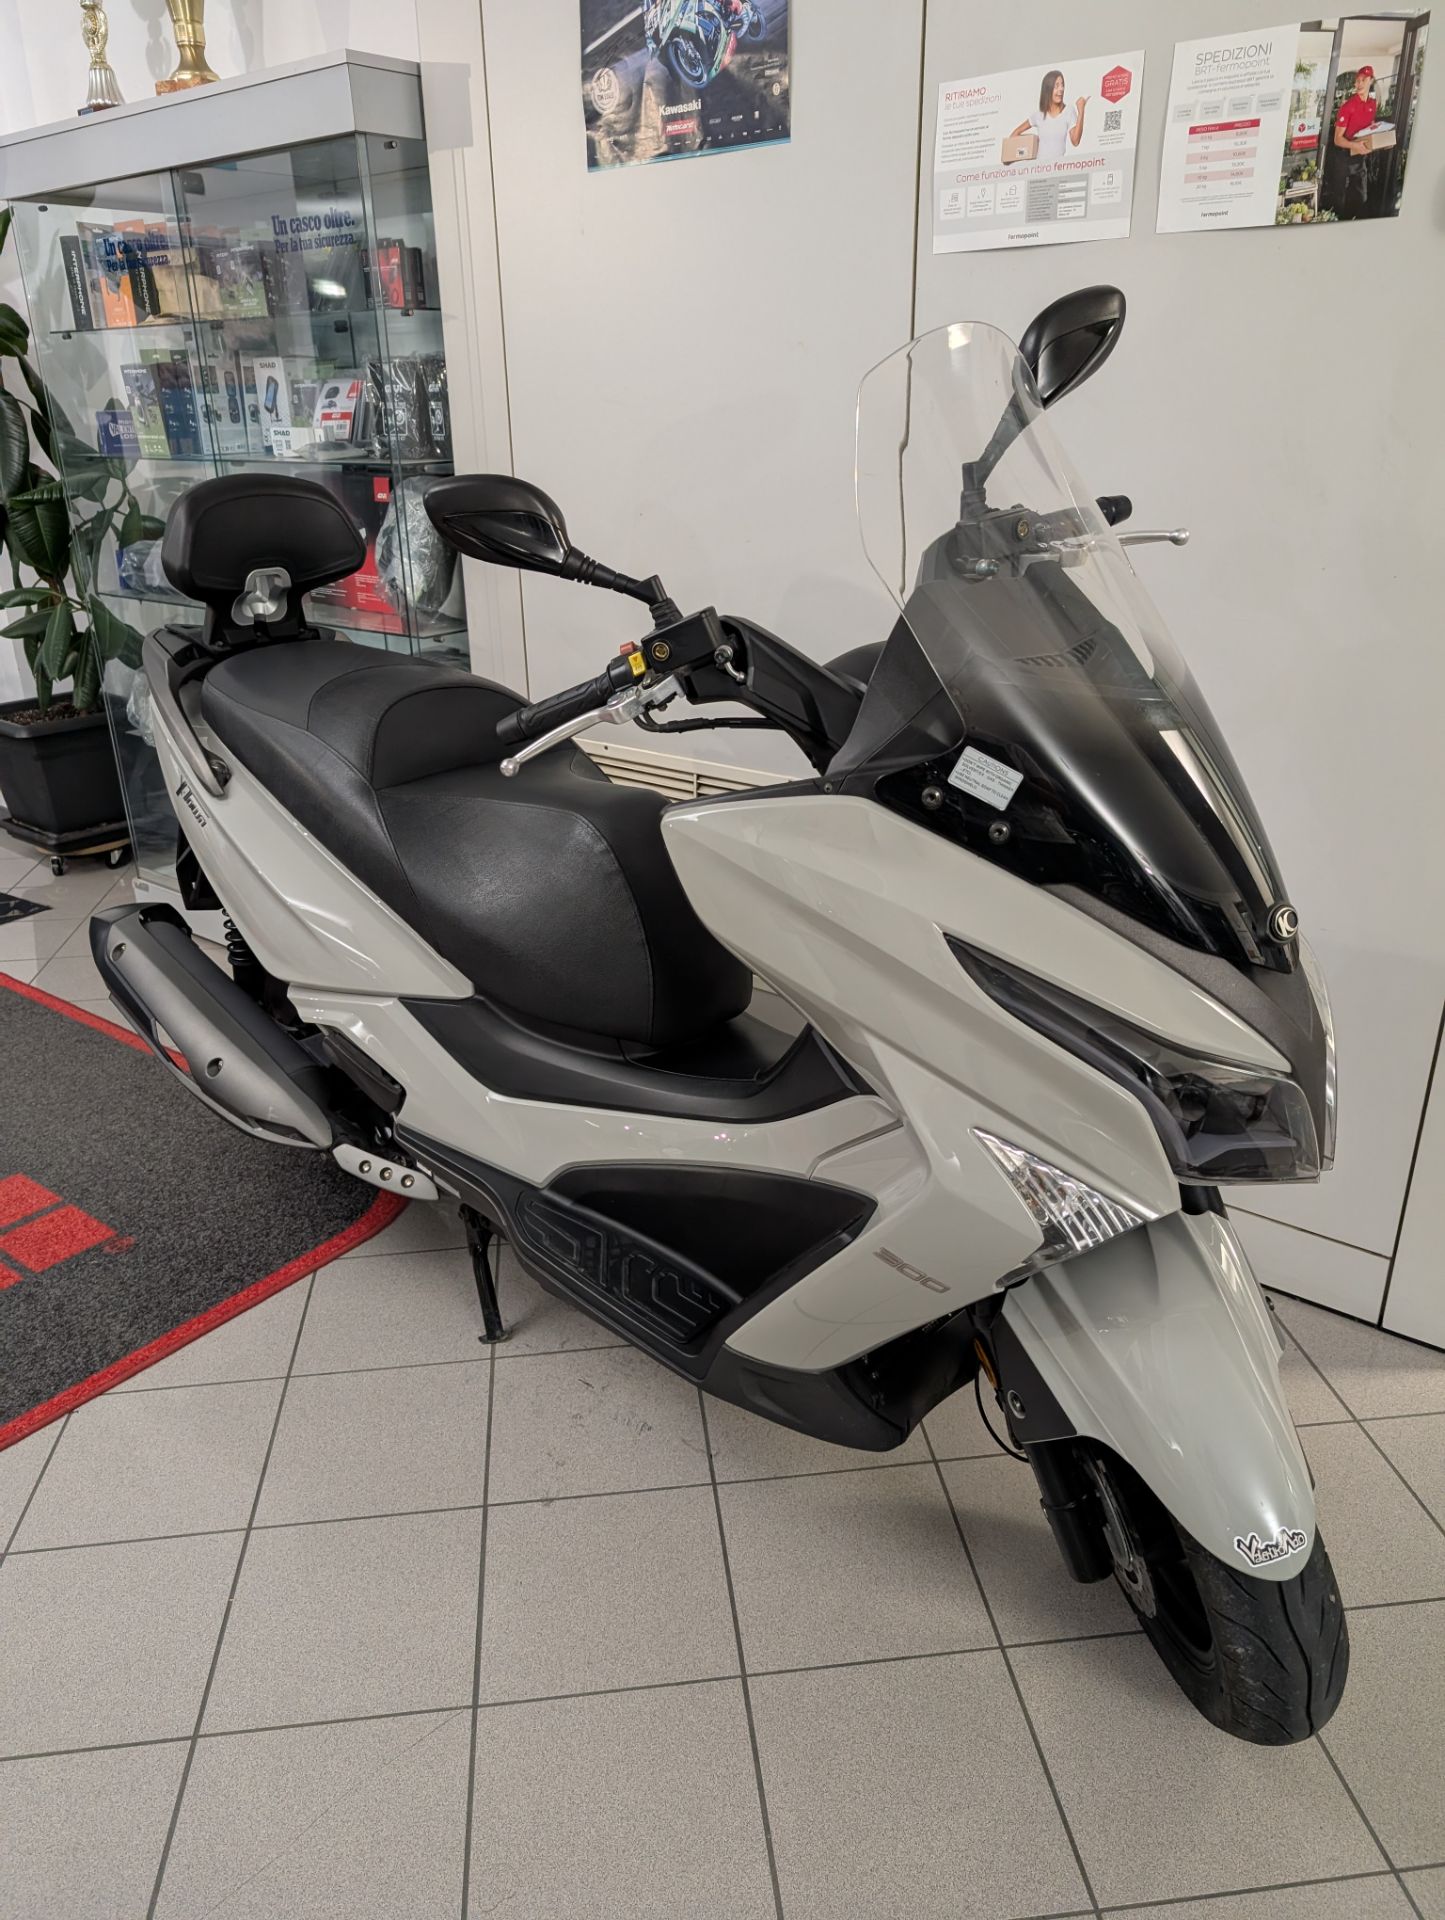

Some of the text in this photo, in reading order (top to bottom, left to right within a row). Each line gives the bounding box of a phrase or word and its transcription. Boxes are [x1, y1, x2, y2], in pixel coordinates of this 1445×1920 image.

[1195, 41, 1273, 66] SPEDIZIONI
[1194, 58, 1271, 76] BRT-fermopoint
[945, 87, 987, 102] RITIRIAMO
[966, 95, 1002, 108] spedizioni
[659, 98, 702, 117] Kawasaki
[956, 157, 1105, 183] Come funziona un ritiro fermopoint
[271, 206, 356, 236] Un casco oltre.
[275, 239, 289, 253] Per
[290, 237, 299, 252] la
[314, 232, 358, 249] sicurezza.
[1007, 231, 1039, 240] fermopoint
[71, 250, 87, 316] INTERPHONE
[273, 429, 291, 437] SHAD
[873, 1247, 951, 1293] 300
